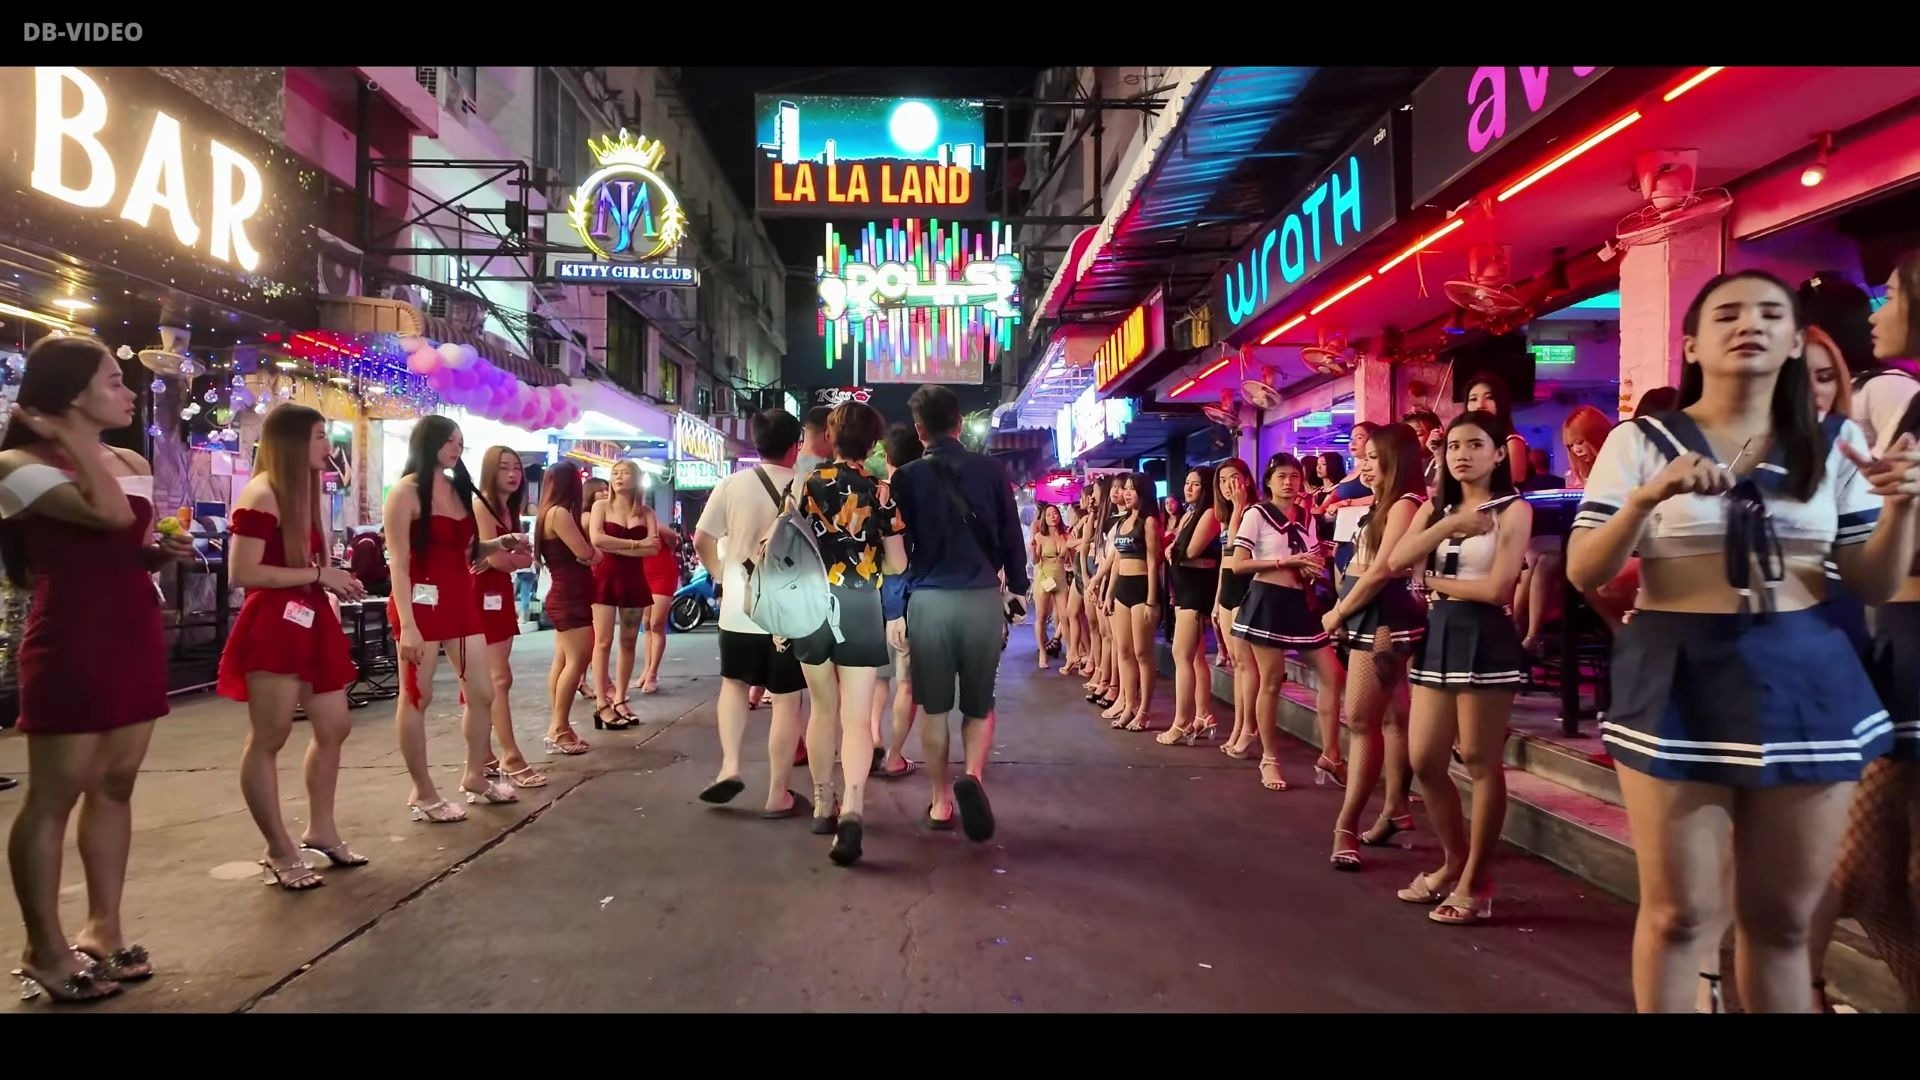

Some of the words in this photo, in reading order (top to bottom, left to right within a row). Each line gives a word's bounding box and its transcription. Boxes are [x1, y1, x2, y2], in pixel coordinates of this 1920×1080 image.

[31, 66, 262, 272] BAR
[773, 162, 816, 203] LA
[827, 163, 870, 203] LA
[881, 164, 972, 205] LAND
[561, 264, 611, 277] KITTY
[611, 265, 650, 279] GIRL
[652, 267, 692, 280] CLUB
[815, 388, 852, 404] Kiss
[325, 481, 337, 492] 99
